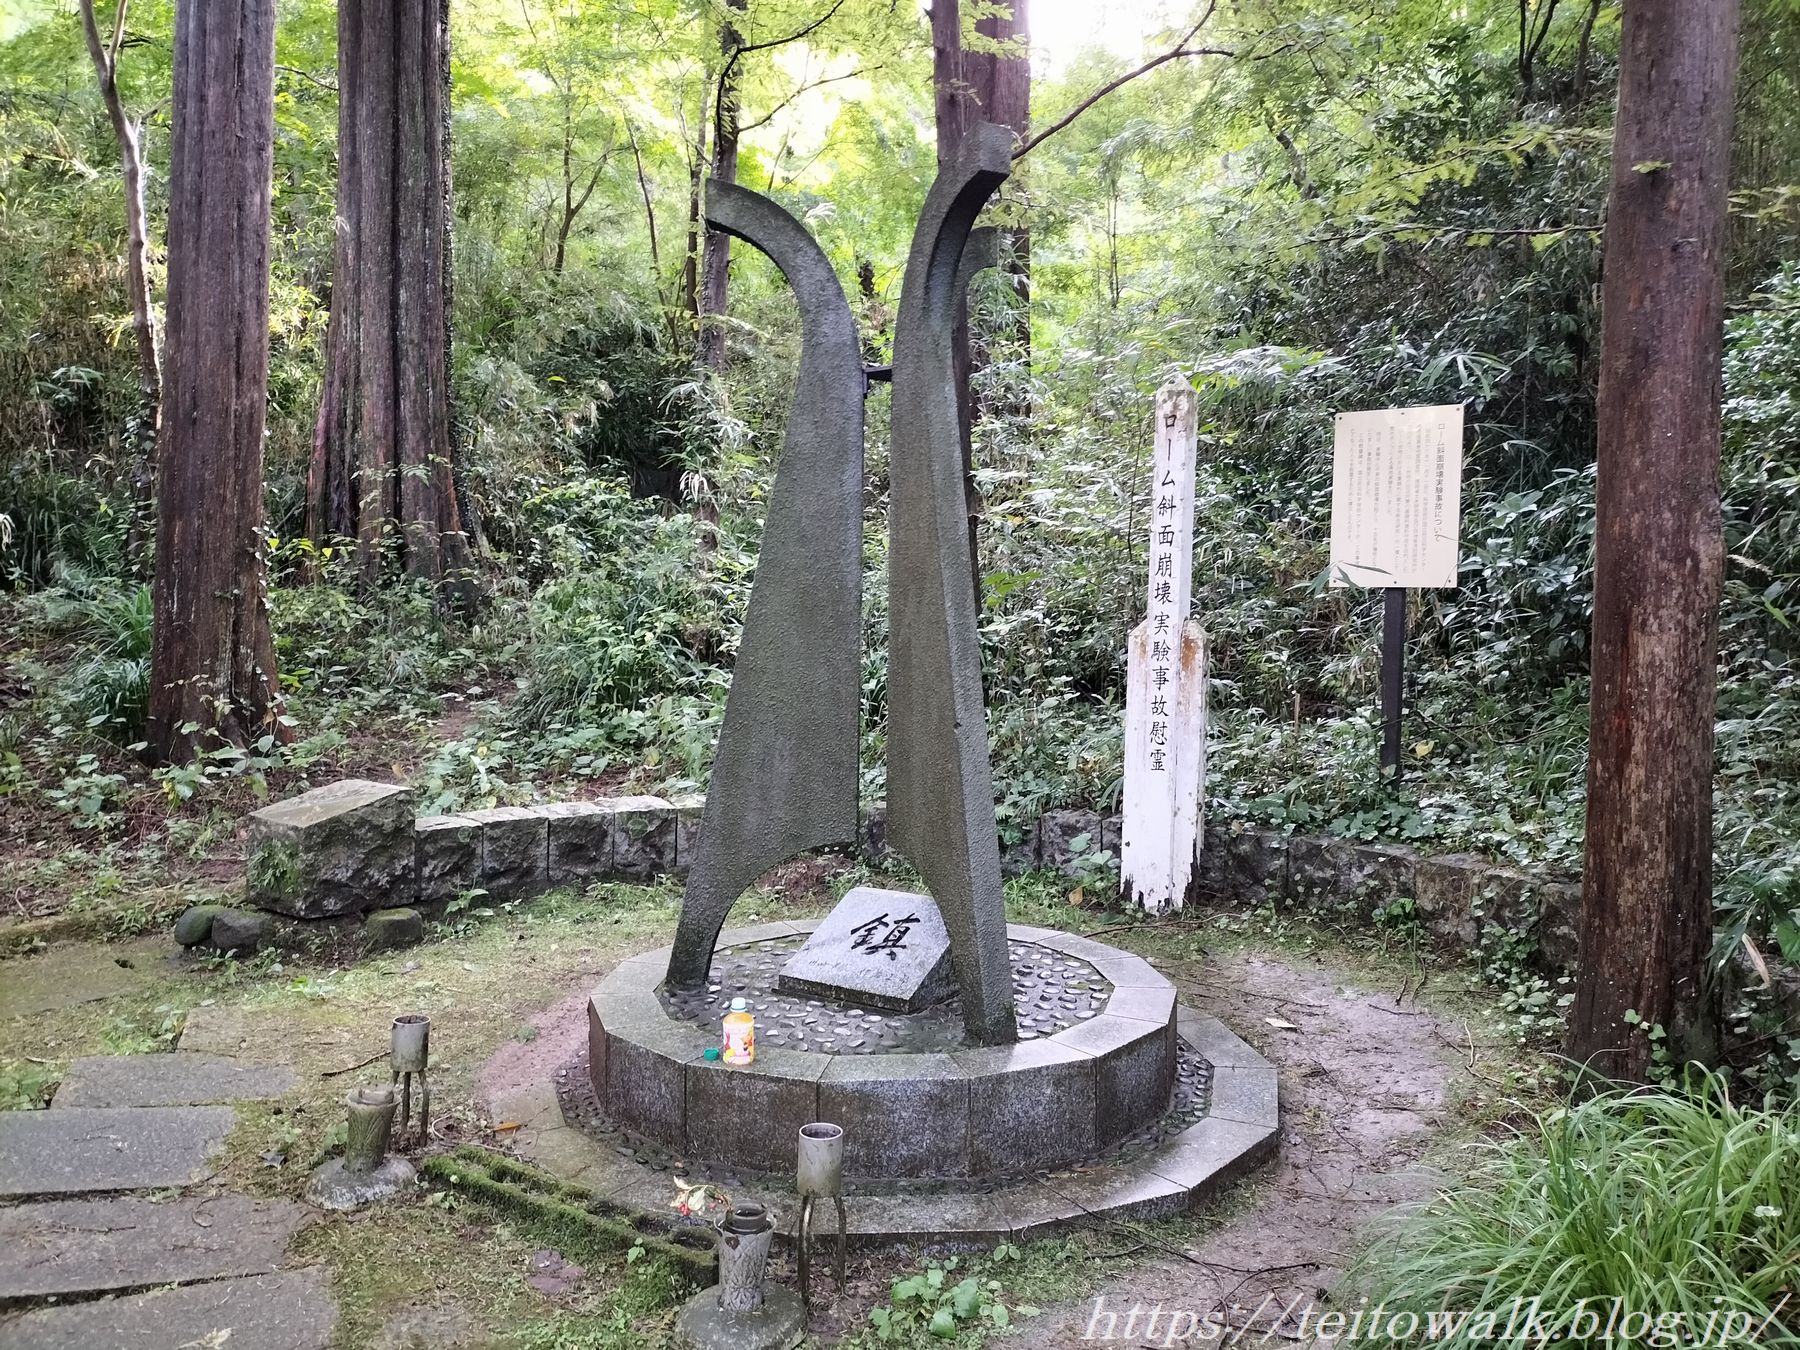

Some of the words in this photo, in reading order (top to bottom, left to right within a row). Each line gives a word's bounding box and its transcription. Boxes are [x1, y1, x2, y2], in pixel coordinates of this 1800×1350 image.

[1149, 413, 1178, 772] ローム斜面崩壊実験事故慰霊
[850, 912, 921, 961] 鎮
